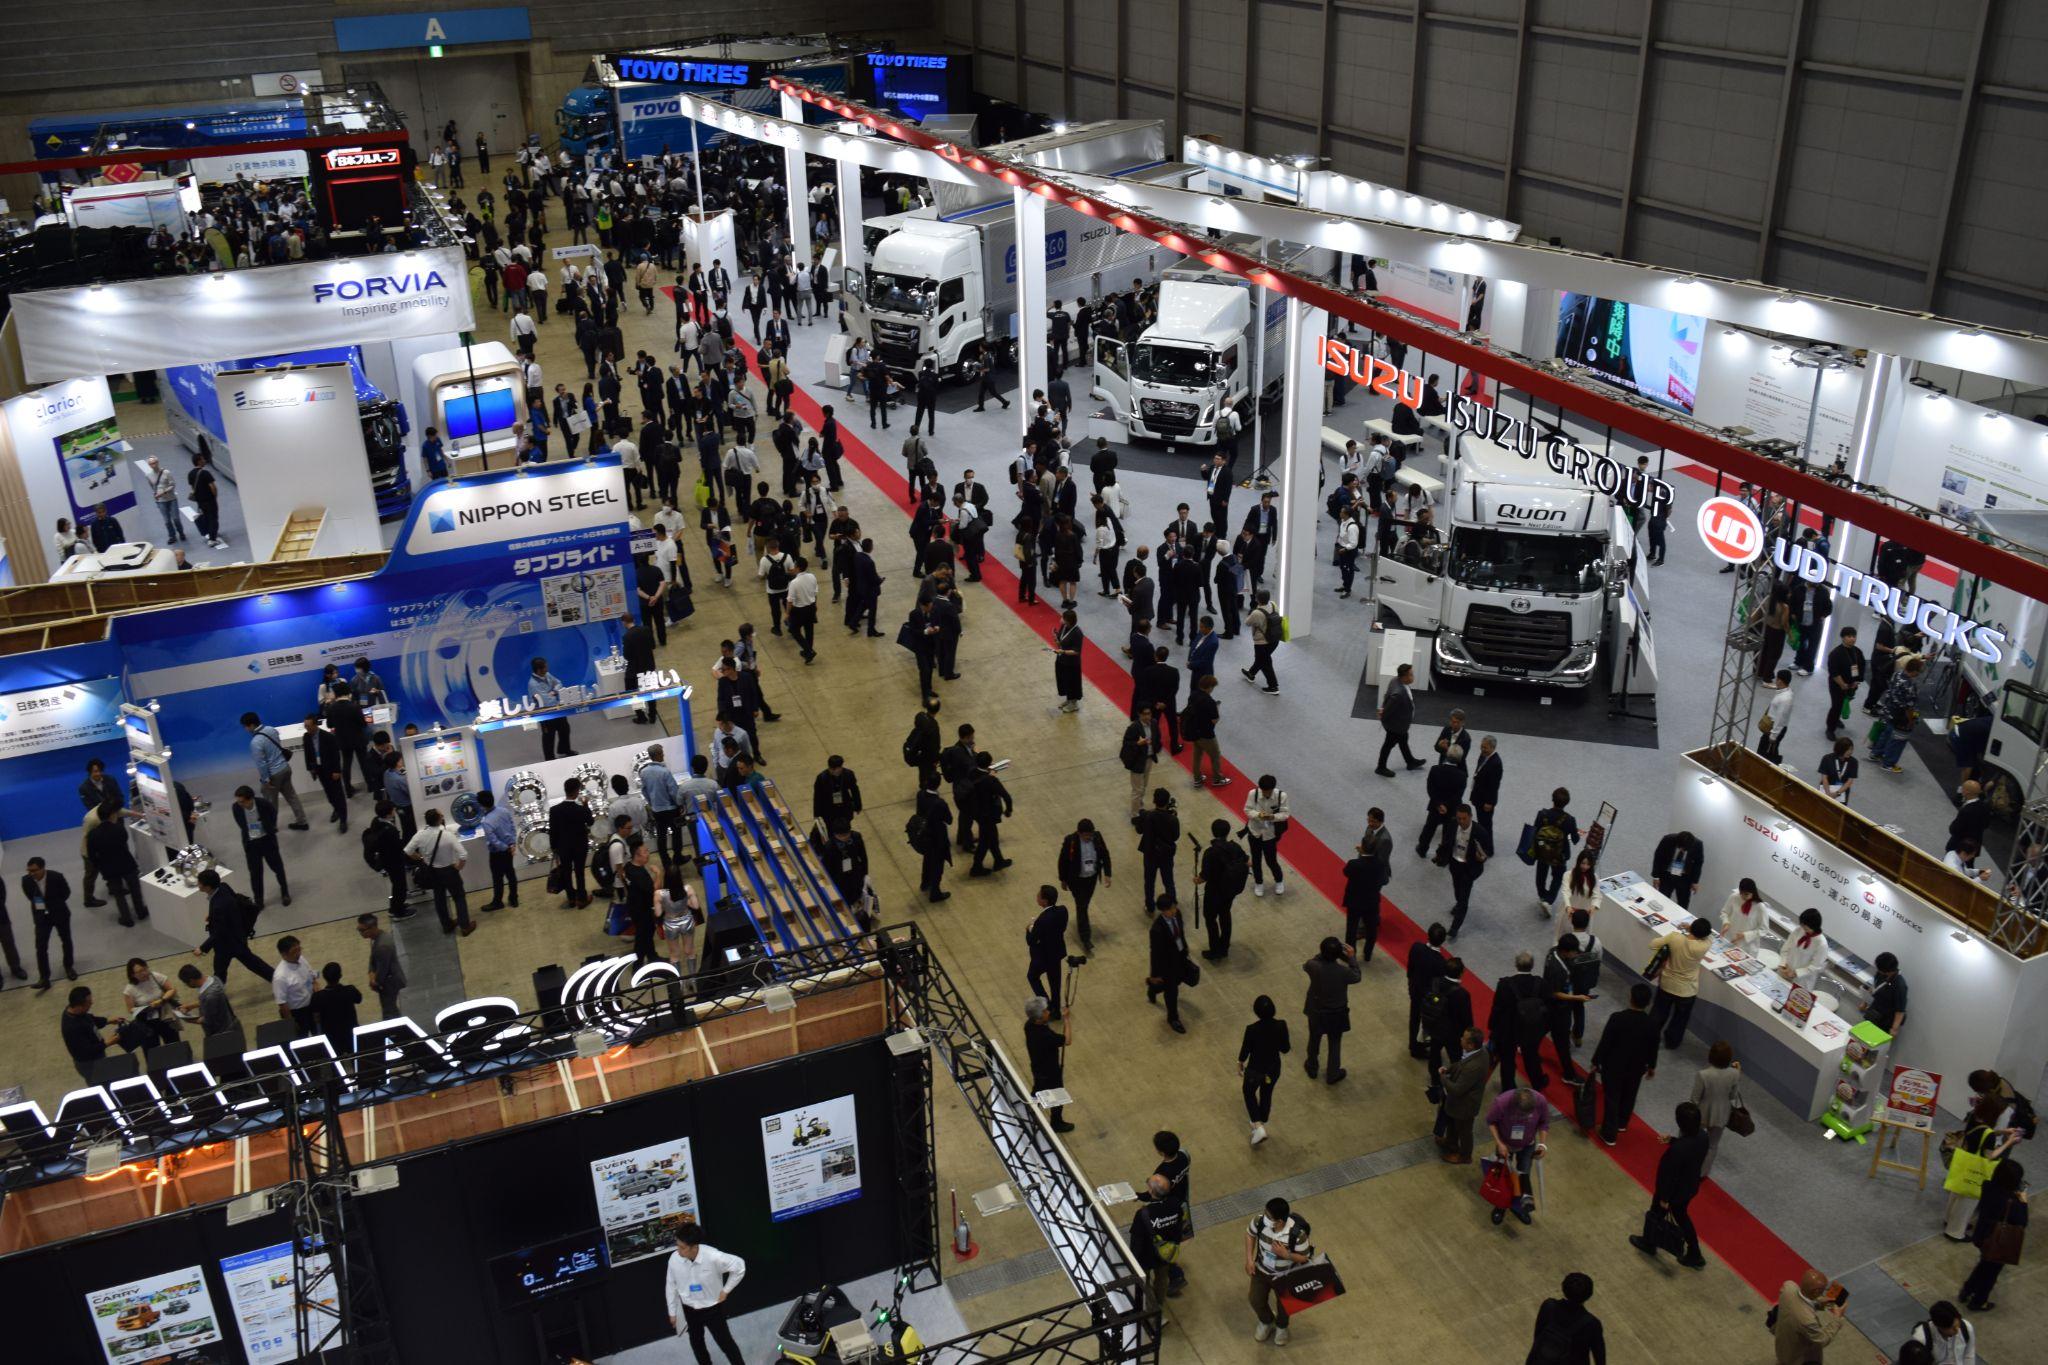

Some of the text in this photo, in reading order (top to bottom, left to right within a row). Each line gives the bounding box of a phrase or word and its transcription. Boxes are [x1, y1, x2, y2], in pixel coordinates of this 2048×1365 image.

[425, 18, 447, 40] A
[619, 59, 749, 85] TOYO TIRES
[867, 54, 947, 69] TOYO TIRES
[633, 100, 680, 117] TOYO
[1080, 225, 1111, 243] ISUZU
[313, 270, 447, 303] FORVIA
[341, 295, 450, 318] Inspiring mobility
[1317, 335, 1425, 409] ISUZU
[1445, 390, 1675, 517] ISUZU GROUP
[459, 489, 619, 526] NIPPON STEEL
[1497, 503, 1567, 522] Quon
[1703, 508, 1755, 554] UD
[635, 541, 653, 550] A-18
[1773, 537, 1828, 584] UD
[1832, 562, 2005, 664] TRUCKS
[637, 669, 680, 692] 強い
[1502, 665, 1526, 674] Quon
[17, 697, 61, 712] 日鉄物産
[479, 693, 543, 720] 美しい
[1744, 815, 1780, 842] ISUZU
[1790, 845, 1850, 887] ISUZU GROUP
[1771, 851, 1885, 930] ともに創る、運ぶの最適
[1879, 901, 1924, 934] UD TRUCKS
[595, 1158, 636, 1172] EVERY
[93, 1287, 141, 1305] CARRY
